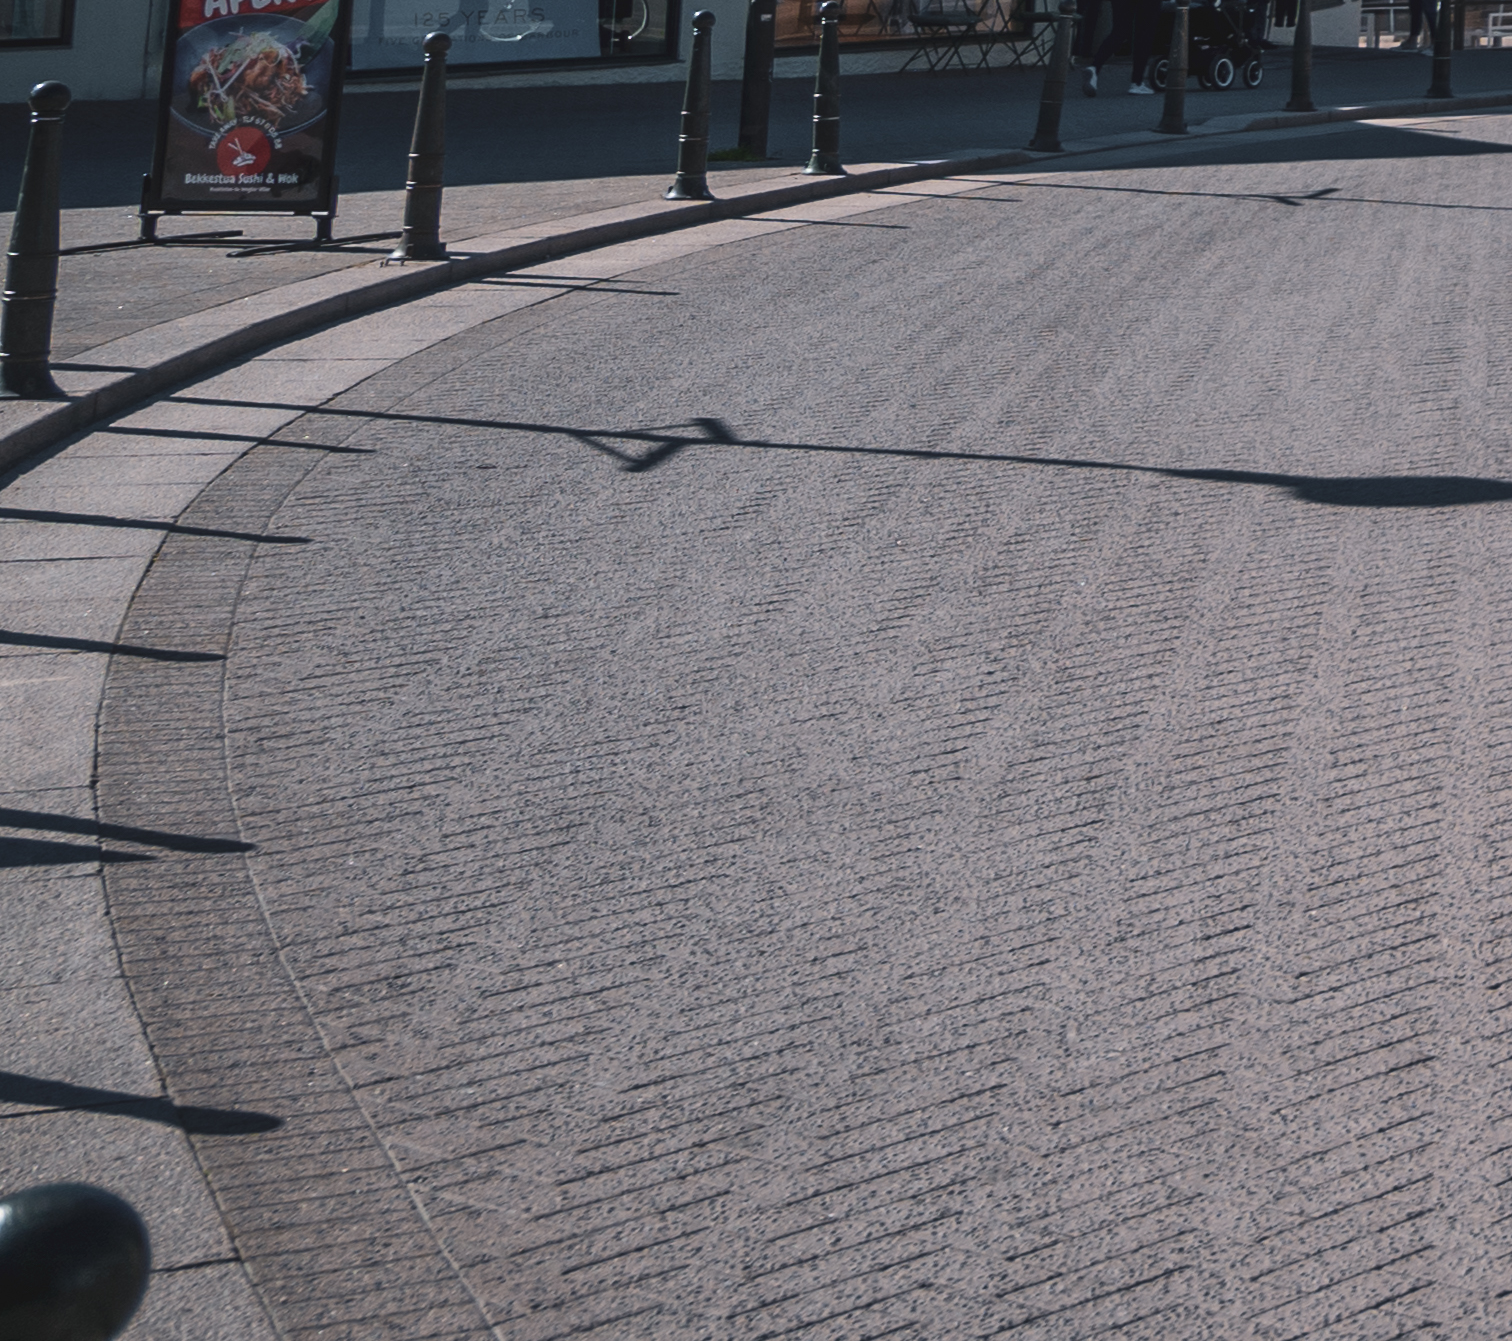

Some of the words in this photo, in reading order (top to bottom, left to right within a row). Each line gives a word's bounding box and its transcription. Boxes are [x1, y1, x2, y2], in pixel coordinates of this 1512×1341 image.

[414, 13, 451, 28] 125
[461, 7, 546, 26] YEARS
[185, 173, 236, 185] Bekkestua
[238, 173, 264, 185] Sushi
[265, 172, 275, 184] &
[277, 173, 299, 184] Wok
